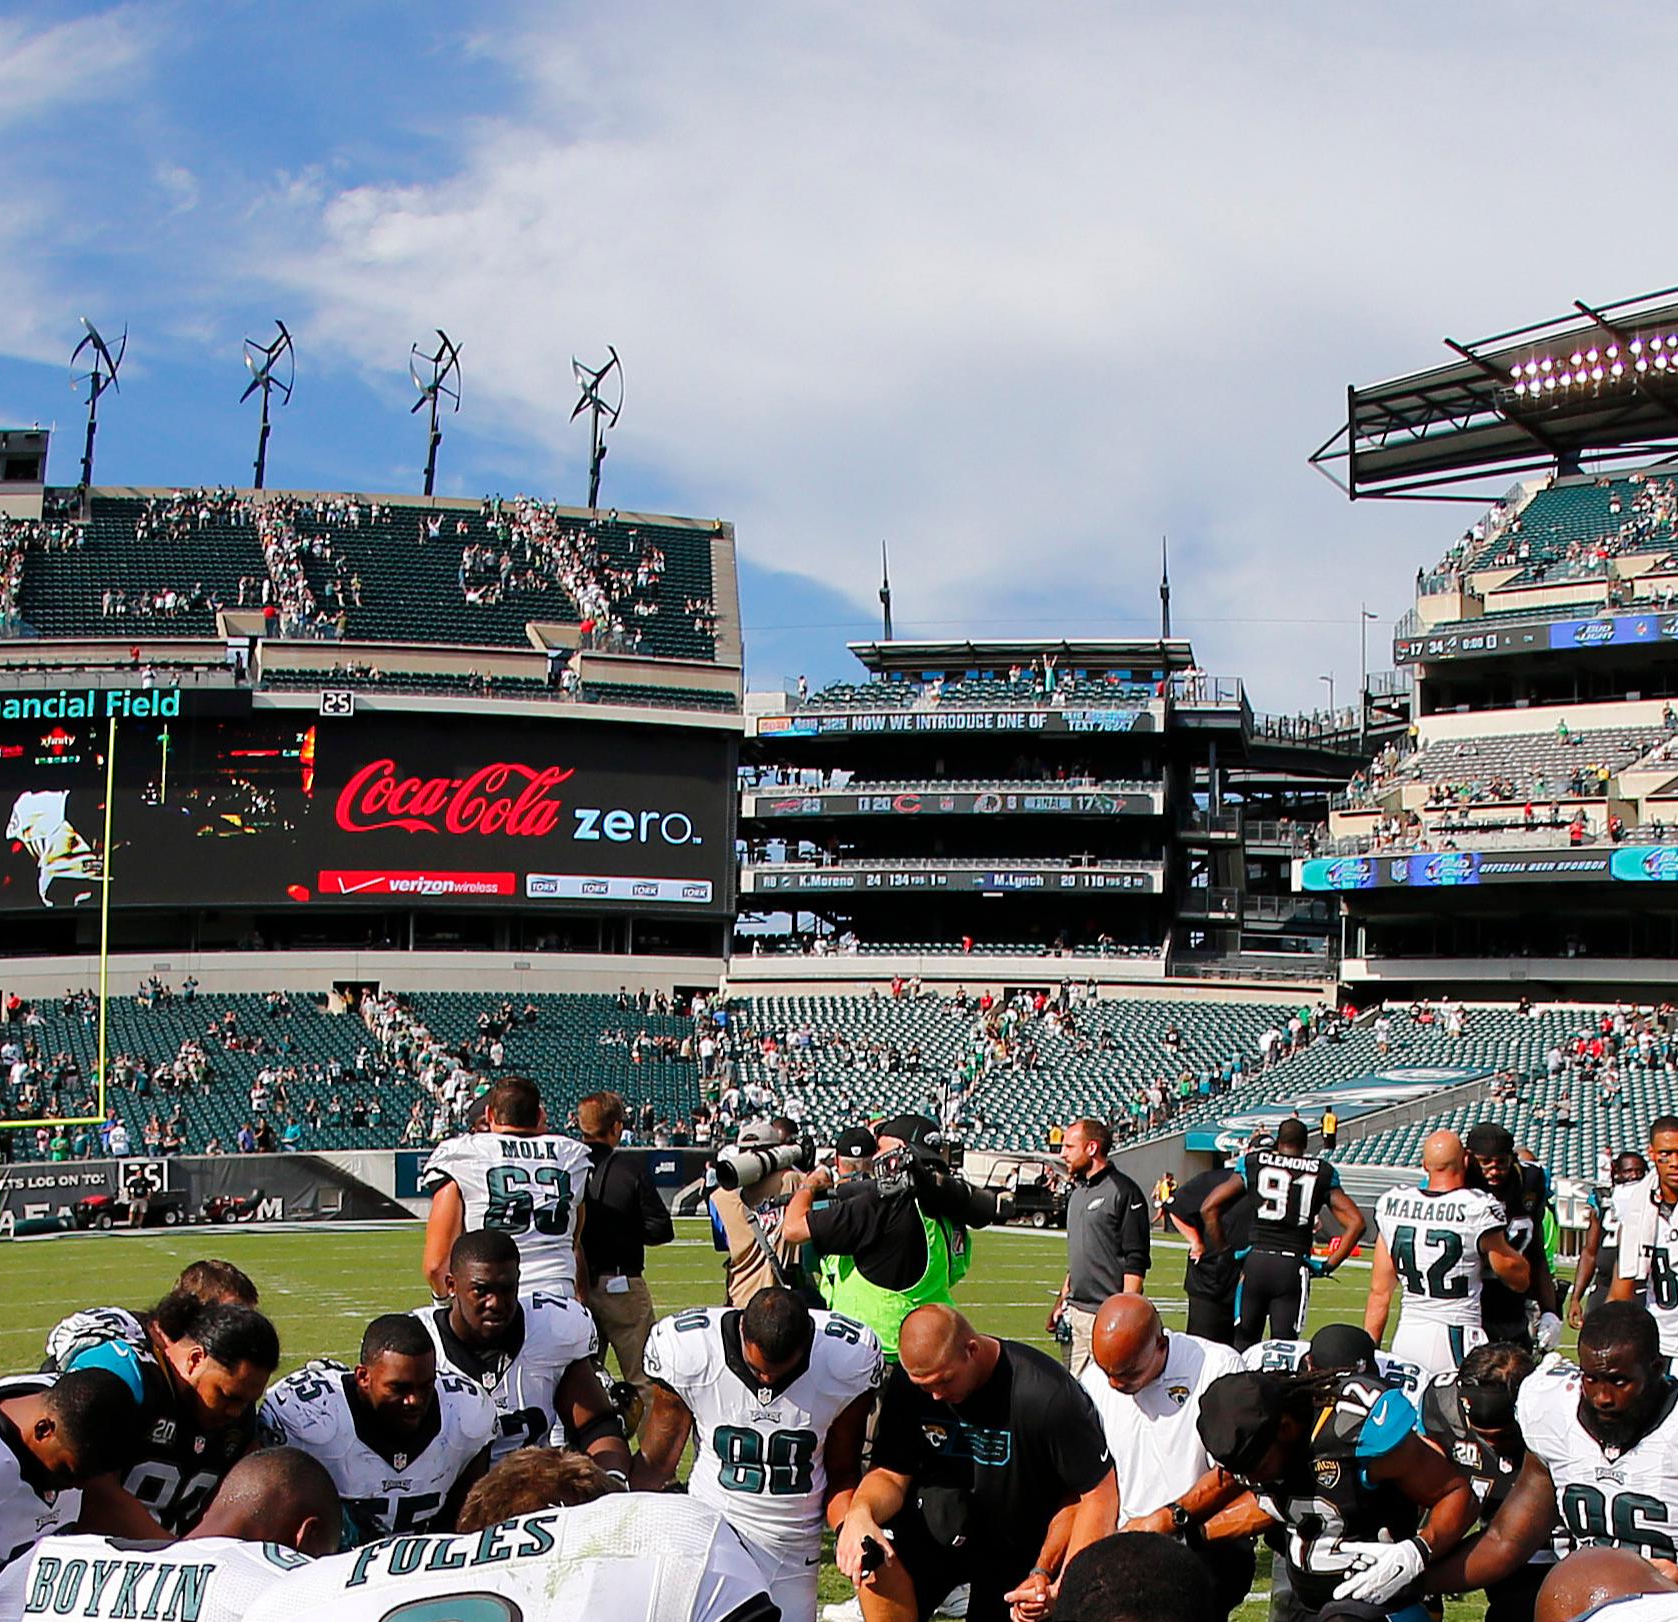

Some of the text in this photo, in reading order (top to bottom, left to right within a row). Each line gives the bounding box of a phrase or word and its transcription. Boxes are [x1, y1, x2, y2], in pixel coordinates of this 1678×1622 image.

[1576, 630, 1615, 643] LIGHT
[1585, 623, 1614, 635] BUD
[1410, 643, 1423, 656] 17
[106, 688, 180, 718] Field
[323, 694, 351, 713] 25
[852, 716, 887, 732] NOW
[889, 715, 914, 731] WE
[916, 713, 994, 731] INTRODUCE
[996, 714, 1027, 730] ONE
[1029, 713, 1048, 729] OF
[40, 734, 76, 748] xfinity
[335, 758, 693, 845] Coca-Cola zero
[802, 798, 821, 811] 23
[872, 797, 891, 811] 20
[1078, 796, 1095, 810] 17
[532, 882, 558, 894] TORK
[799, 875, 854, 888] K.Moreno
[866, 874, 881, 887] 24
[888, 874, 910, 887] 134
[993, 875, 1045, 888] M.Lynch
[1060, 875, 1076, 888] 20
[1083, 875, 1105, 888] 110
[582, 883, 608, 895] TORK
[632, 884, 658, 896] TORK
[682, 887, 707, 899] TORK
[501, 1139, 558, 1160] MOLK
[1258, 1151, 1320, 1172] CLEMONS
[28, 1176, 56, 1189] LOG
[58, 1174, 79, 1186] ON
[82, 1173, 106, 1185] TO:
[484, 1164, 574, 1236] 63
[1257, 1167, 1318, 1226] 91
[1384, 1196, 1467, 1222] MARAGOS
[1391, 1225, 1469, 1299] 42
[345, 1514, 556, 1588] FOLES
